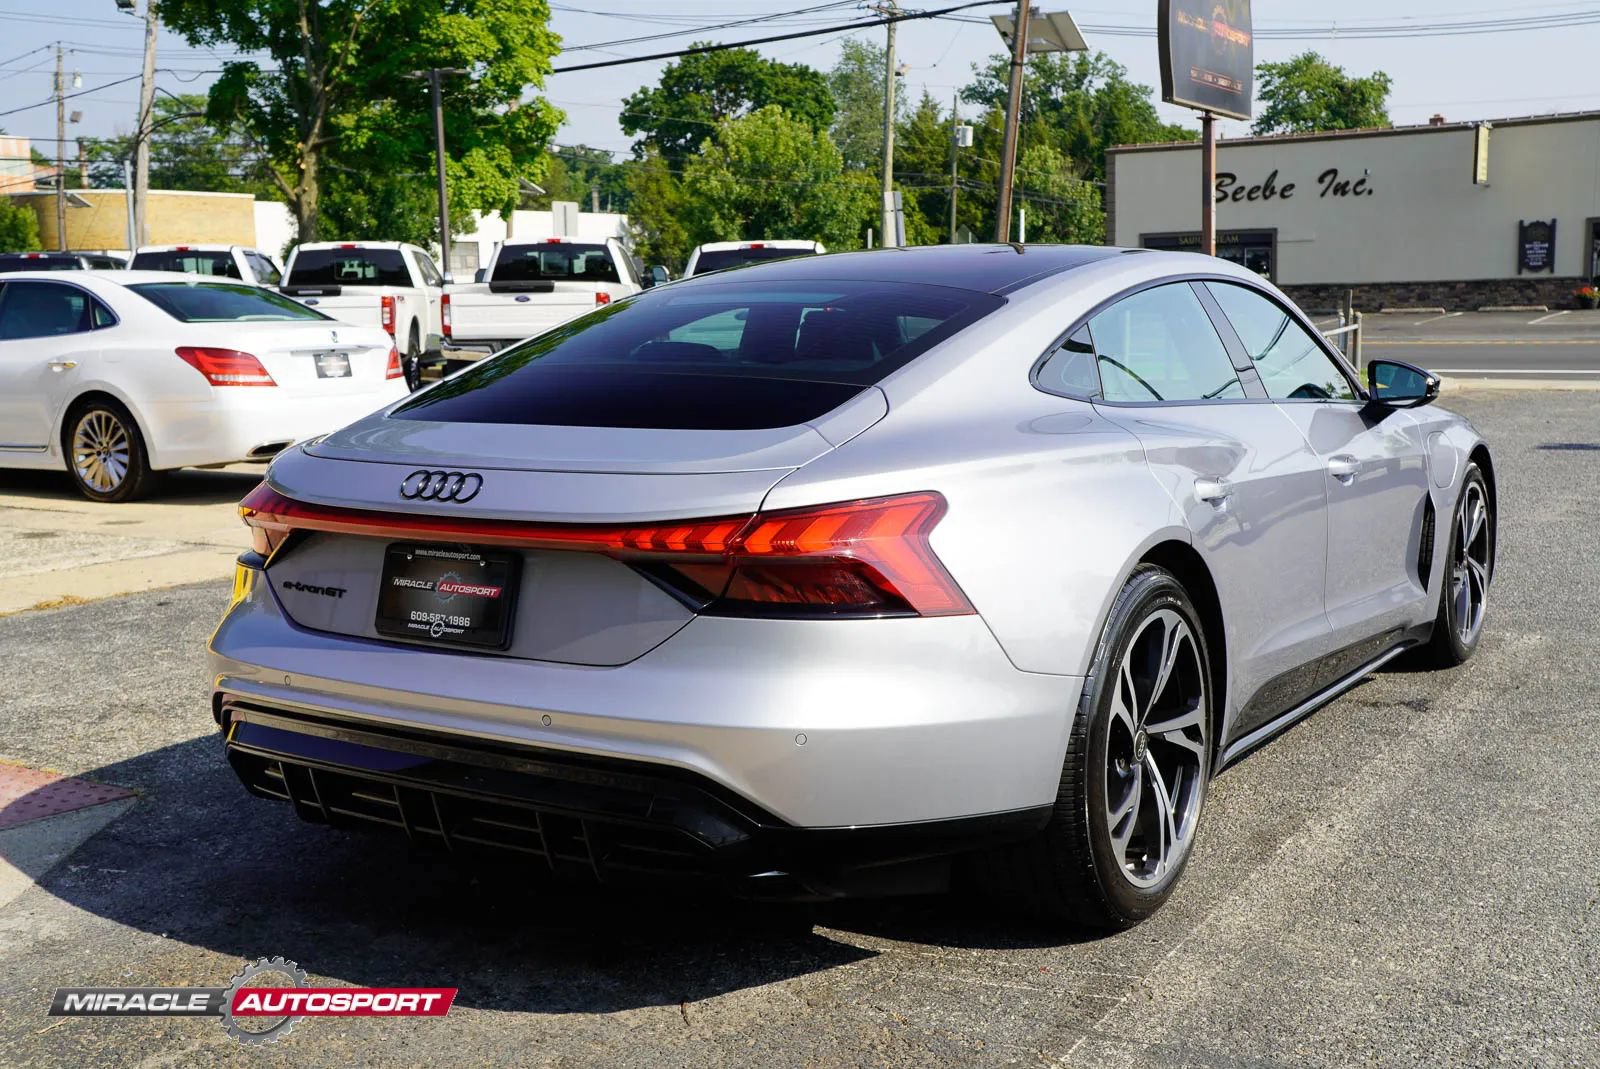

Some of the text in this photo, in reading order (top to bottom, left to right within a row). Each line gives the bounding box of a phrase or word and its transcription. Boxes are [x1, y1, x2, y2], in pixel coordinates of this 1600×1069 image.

[1215, 168, 1374, 203] Beebe Inc.
[415, 548, 481, 560] www.miracleautosport.com
[393, 578, 498, 596] MIRACLE AUTOSPORT
[407, 622, 430, 630] MIRACLE
[410, 610, 471, 628] 609-587-1986
